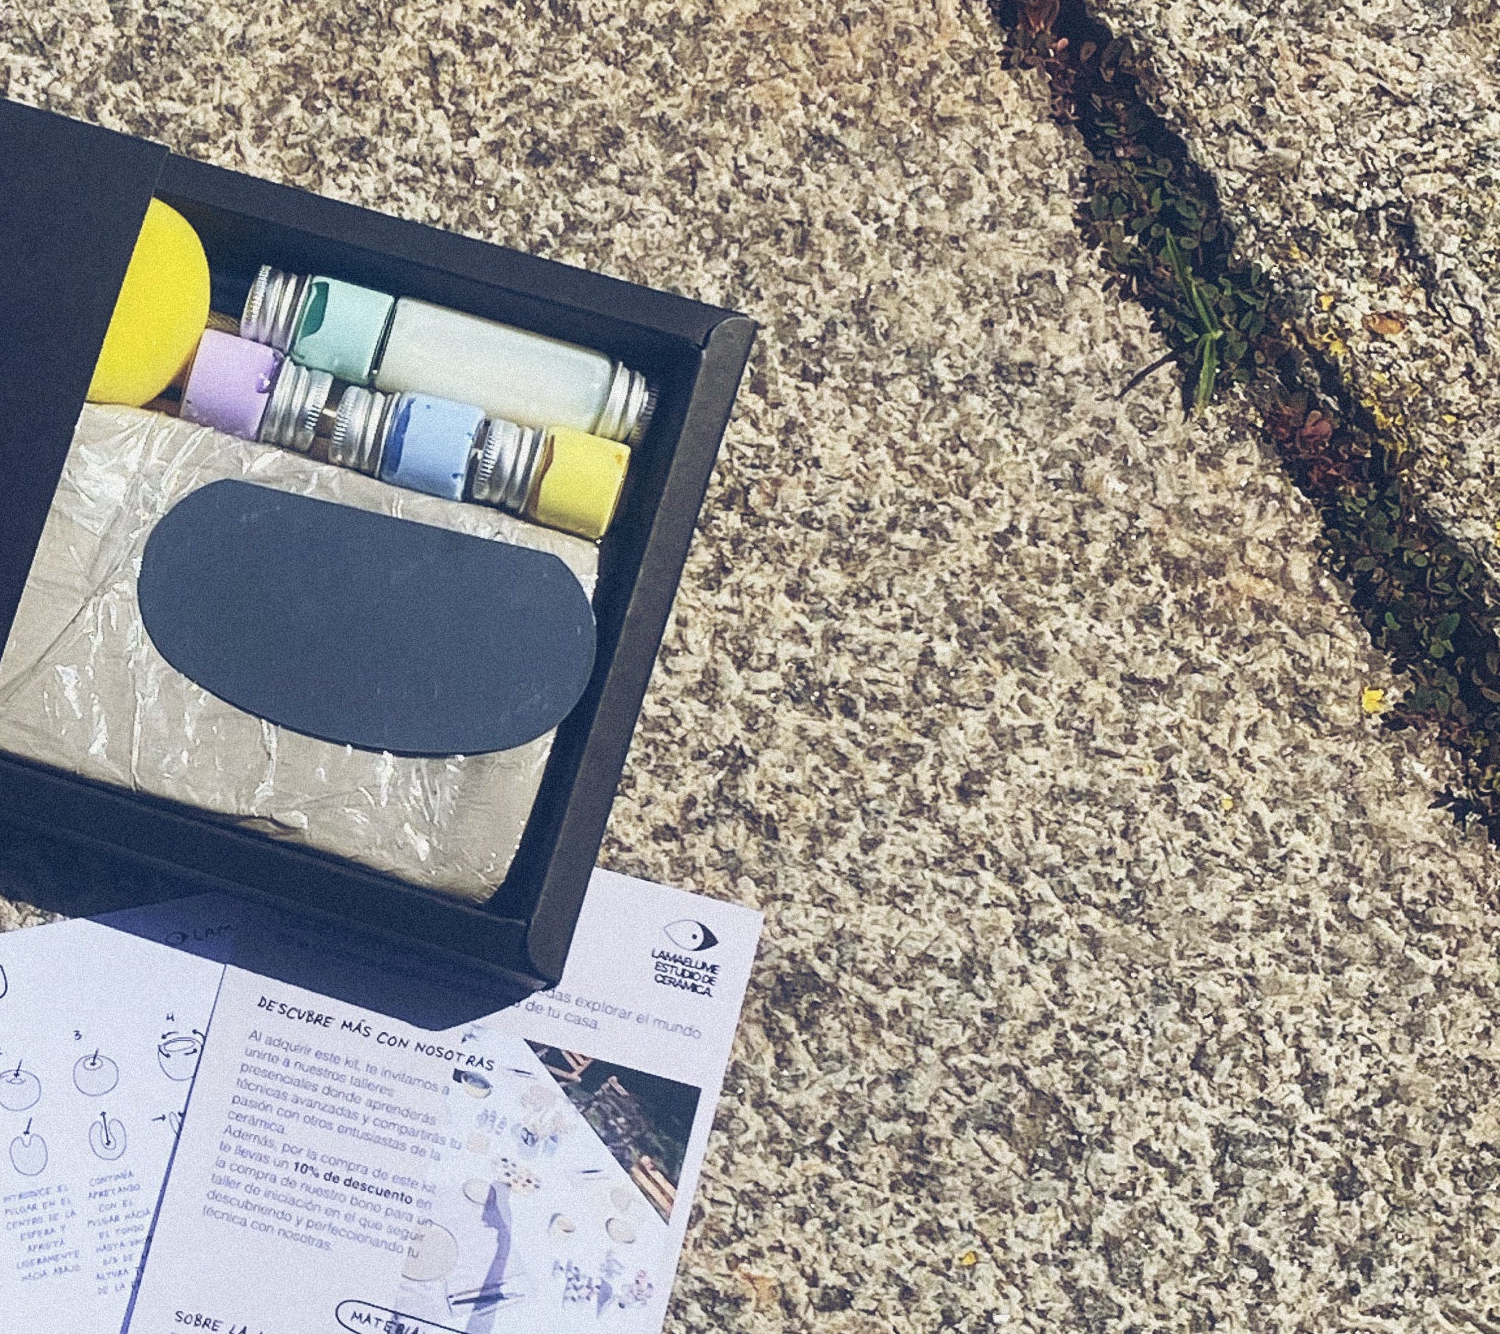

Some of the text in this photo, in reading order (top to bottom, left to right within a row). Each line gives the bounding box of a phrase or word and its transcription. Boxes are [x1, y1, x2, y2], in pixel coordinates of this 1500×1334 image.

[654, 961, 717, 986] ESTUDIO DE
[72, 1029, 82, 1041] 3
[165, 1011, 175, 1022] 4
[524, 1001, 544, 1014] de
[547, 1005, 560, 1019] tu
[574, 996, 632, 1019] explorar
[635, 1013, 649, 1024] el
[652, 1017, 701, 1039] mundo
[244, 1046, 394, 1097] unirte a nuestros talleres
[247, 1028, 262, 1042] Al
[264, 1035, 312, 1055] adquirir
[313, 1049, 341, 1065] este
[365, 1062, 378, 1075] te
[380, 1067, 438, 1092] invitamos
[441, 1084, 450, 1096] a
[340, 1019, 371, 1038] MÁS
[375, 1031, 409, 1048] CON
[414, 1041, 494, 1071] NOSOTRAS
[235, 1077, 462, 1150] técnicas avanzadas y compartirás tu
[239, 1062, 436, 1125] presenciales donde aprenderás
[230, 1094, 441, 1161] pasión con otros entusiastas de la
[214, 1155, 433, 1227] la compra de nuestro bono para un
[218, 1139, 432, 1209] te llevas un 10% de descuento en
[280, 1142, 304, 1155] por
[305, 1148, 317, 1161] la
[319, 1153, 369, 1175] compra
[371, 1167, 388, 1181] de
[391, 1174, 419, 1189] este
[420, 1180, 436, 1195] kit
[201, 1204, 247, 1227] técnica
[249, 1219, 274, 1233] con
[205, 1189, 419, 1259] descubriendo y perfeccionando tu
[210, 1172, 425, 1242] taller de iniciación en el que seguir
[174, 1310, 223, 1332] SOBRE
